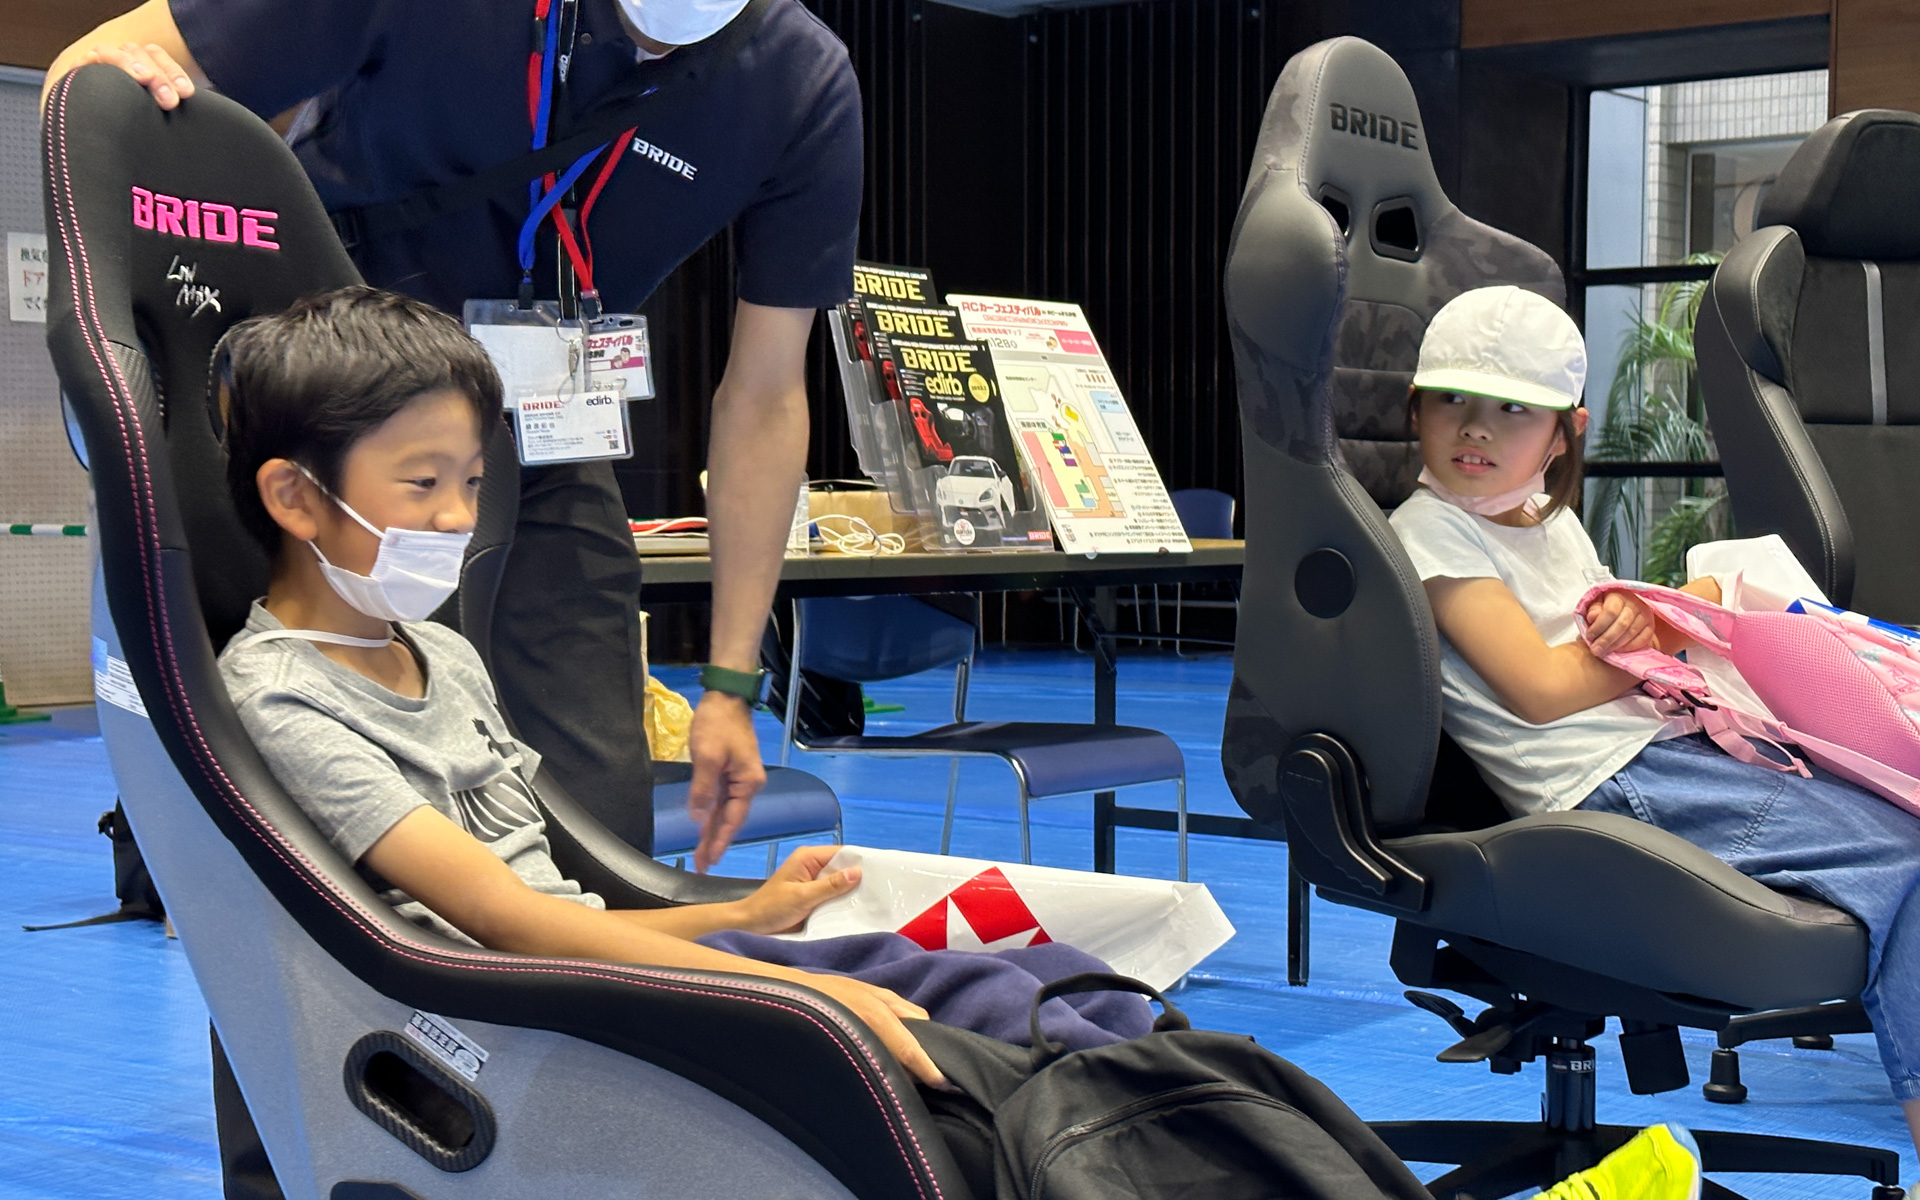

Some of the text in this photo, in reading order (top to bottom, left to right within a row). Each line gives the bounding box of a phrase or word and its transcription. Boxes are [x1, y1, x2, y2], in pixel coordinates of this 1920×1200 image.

[1329, 102, 1419, 151] BRIDE
[632, 137, 698, 181] BRIDE
[131, 185, 281, 251] BRIDE
[853, 271, 926, 301] BRIDE
[961, 301, 1041, 316] RCカーフェスティバル
[875, 310, 954, 338] BRIDE
[900, 347, 976, 373] BRIDE
